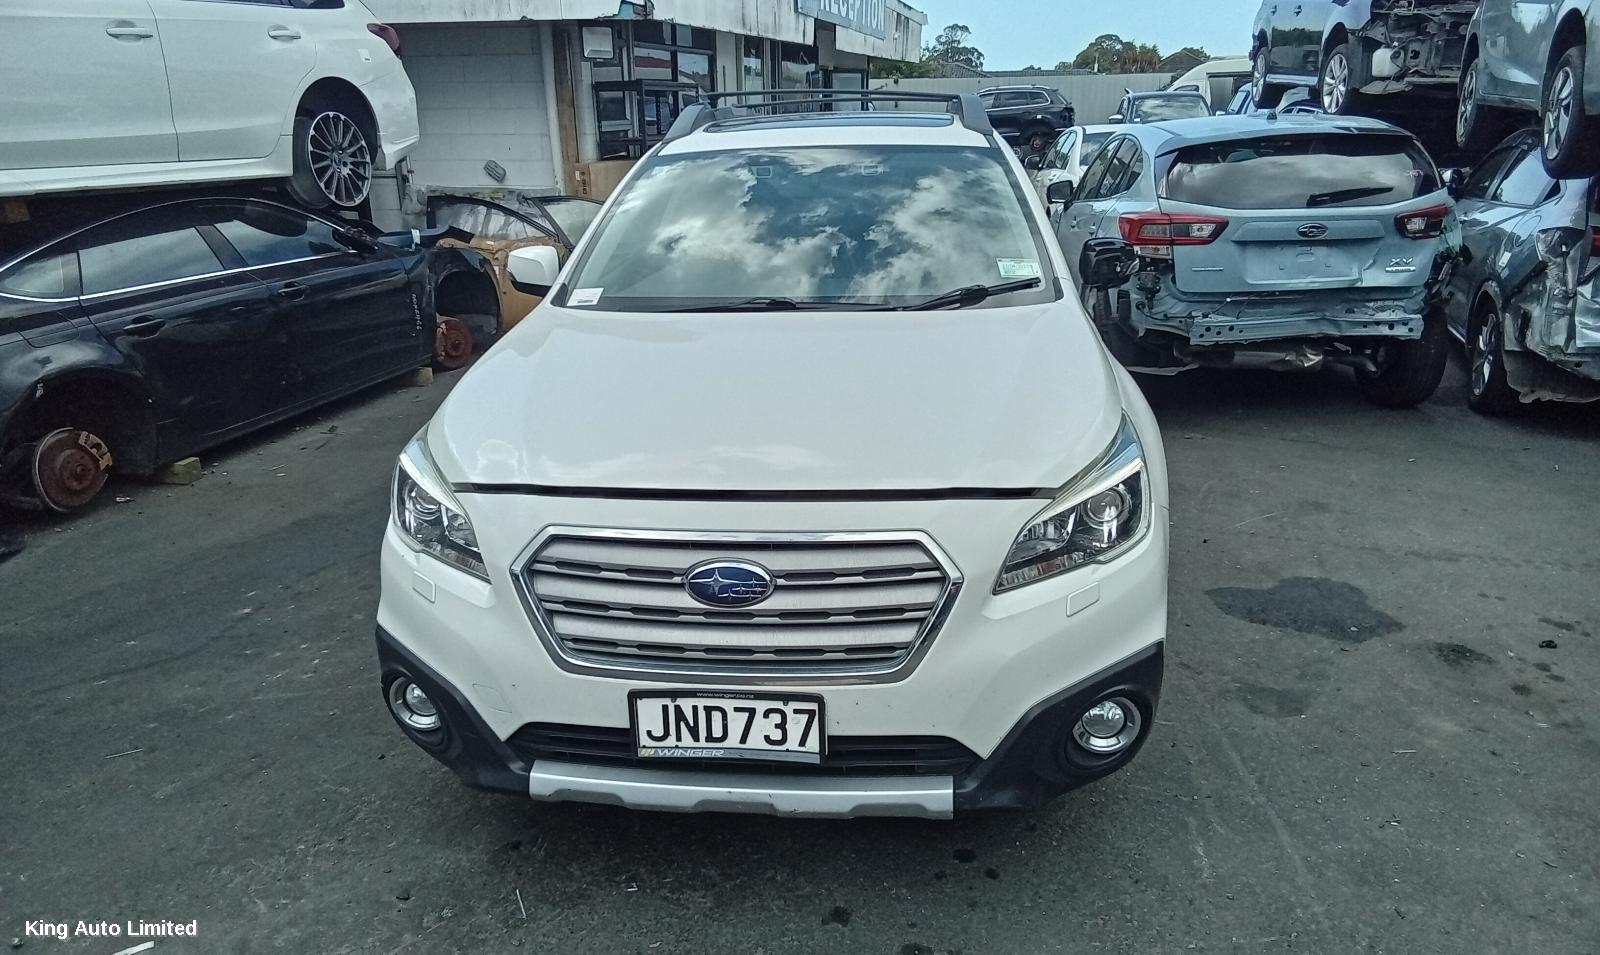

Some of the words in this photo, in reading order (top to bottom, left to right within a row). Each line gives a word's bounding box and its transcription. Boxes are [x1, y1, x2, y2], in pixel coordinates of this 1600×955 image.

[820, 0, 884, 32] CEPTION
[646, 703, 817, 748] JND737
[657, 748, 725, 757] WINGER
